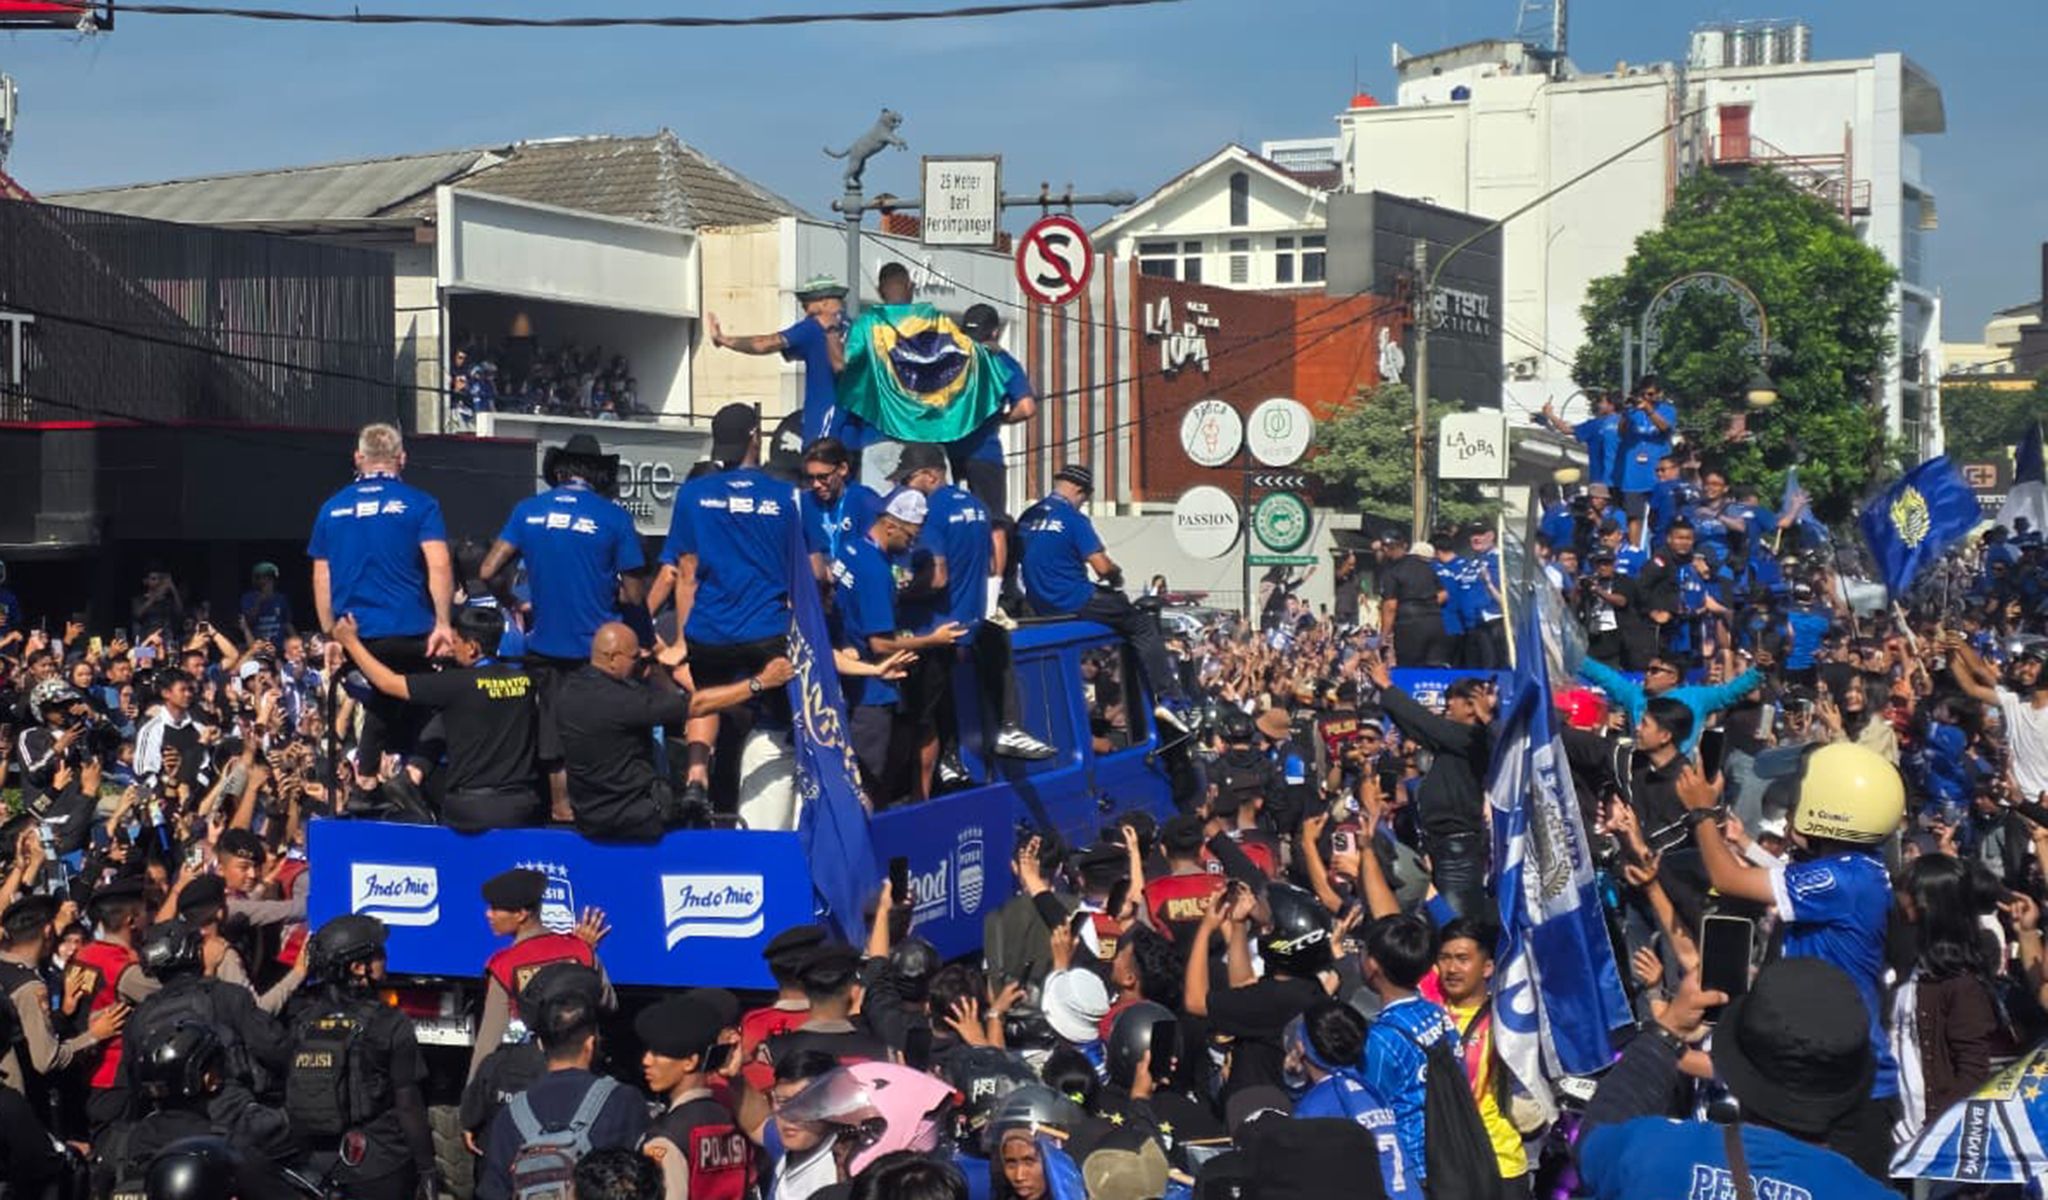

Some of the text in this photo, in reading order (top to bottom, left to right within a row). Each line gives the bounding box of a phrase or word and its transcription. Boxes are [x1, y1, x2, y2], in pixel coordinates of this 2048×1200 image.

[940, 173, 981, 190] 25 Meter
[950, 195, 970, 211] Dari
[927, 216, 992, 236] Persimpangan
[1145, 296, 1173, 335] LA
[1446, 431, 1467, 448] LA
[1459, 439, 1496, 461] LOBA
[1178, 512, 1235, 527] PASSION
[296, 1052, 333, 1068] POLISI
[1963, 1105, 1986, 1175] BANDUNG
[1377, 1133, 1406, 1192] 7
